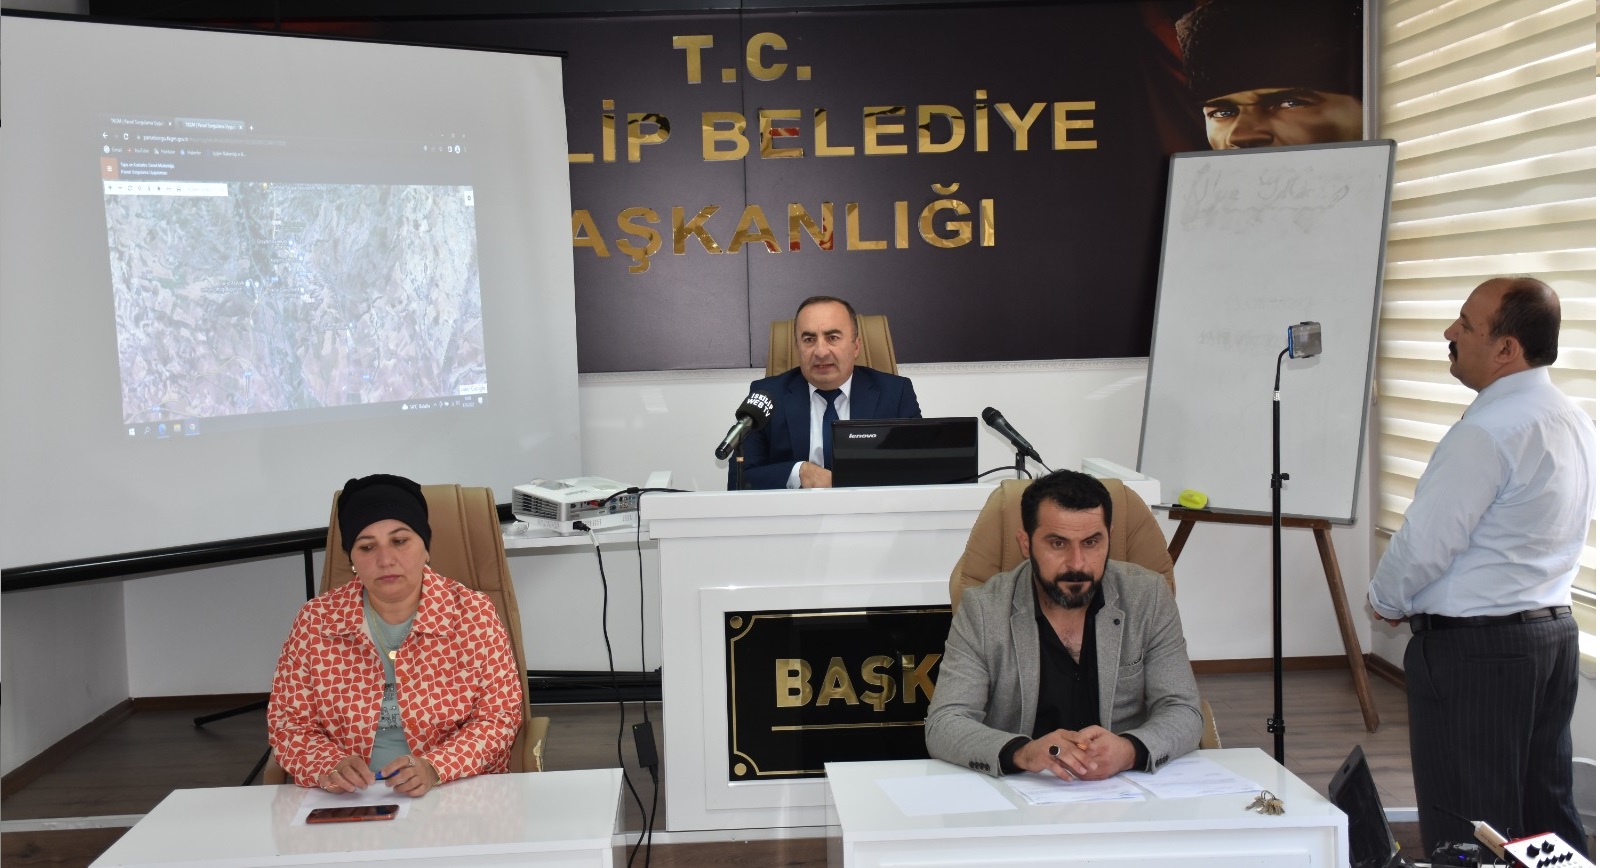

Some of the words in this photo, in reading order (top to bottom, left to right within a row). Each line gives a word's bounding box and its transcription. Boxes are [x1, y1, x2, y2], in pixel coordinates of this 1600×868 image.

[672, 32, 812, 84] T.C.
[568, 99, 672, 163] İP
[701, 89, 1098, 162] BELEDİYE
[571, 182, 996, 274] AŞKANLIĞI
[747, 398, 764, 408] WEB
[775, 654, 942, 712] BAŞK
